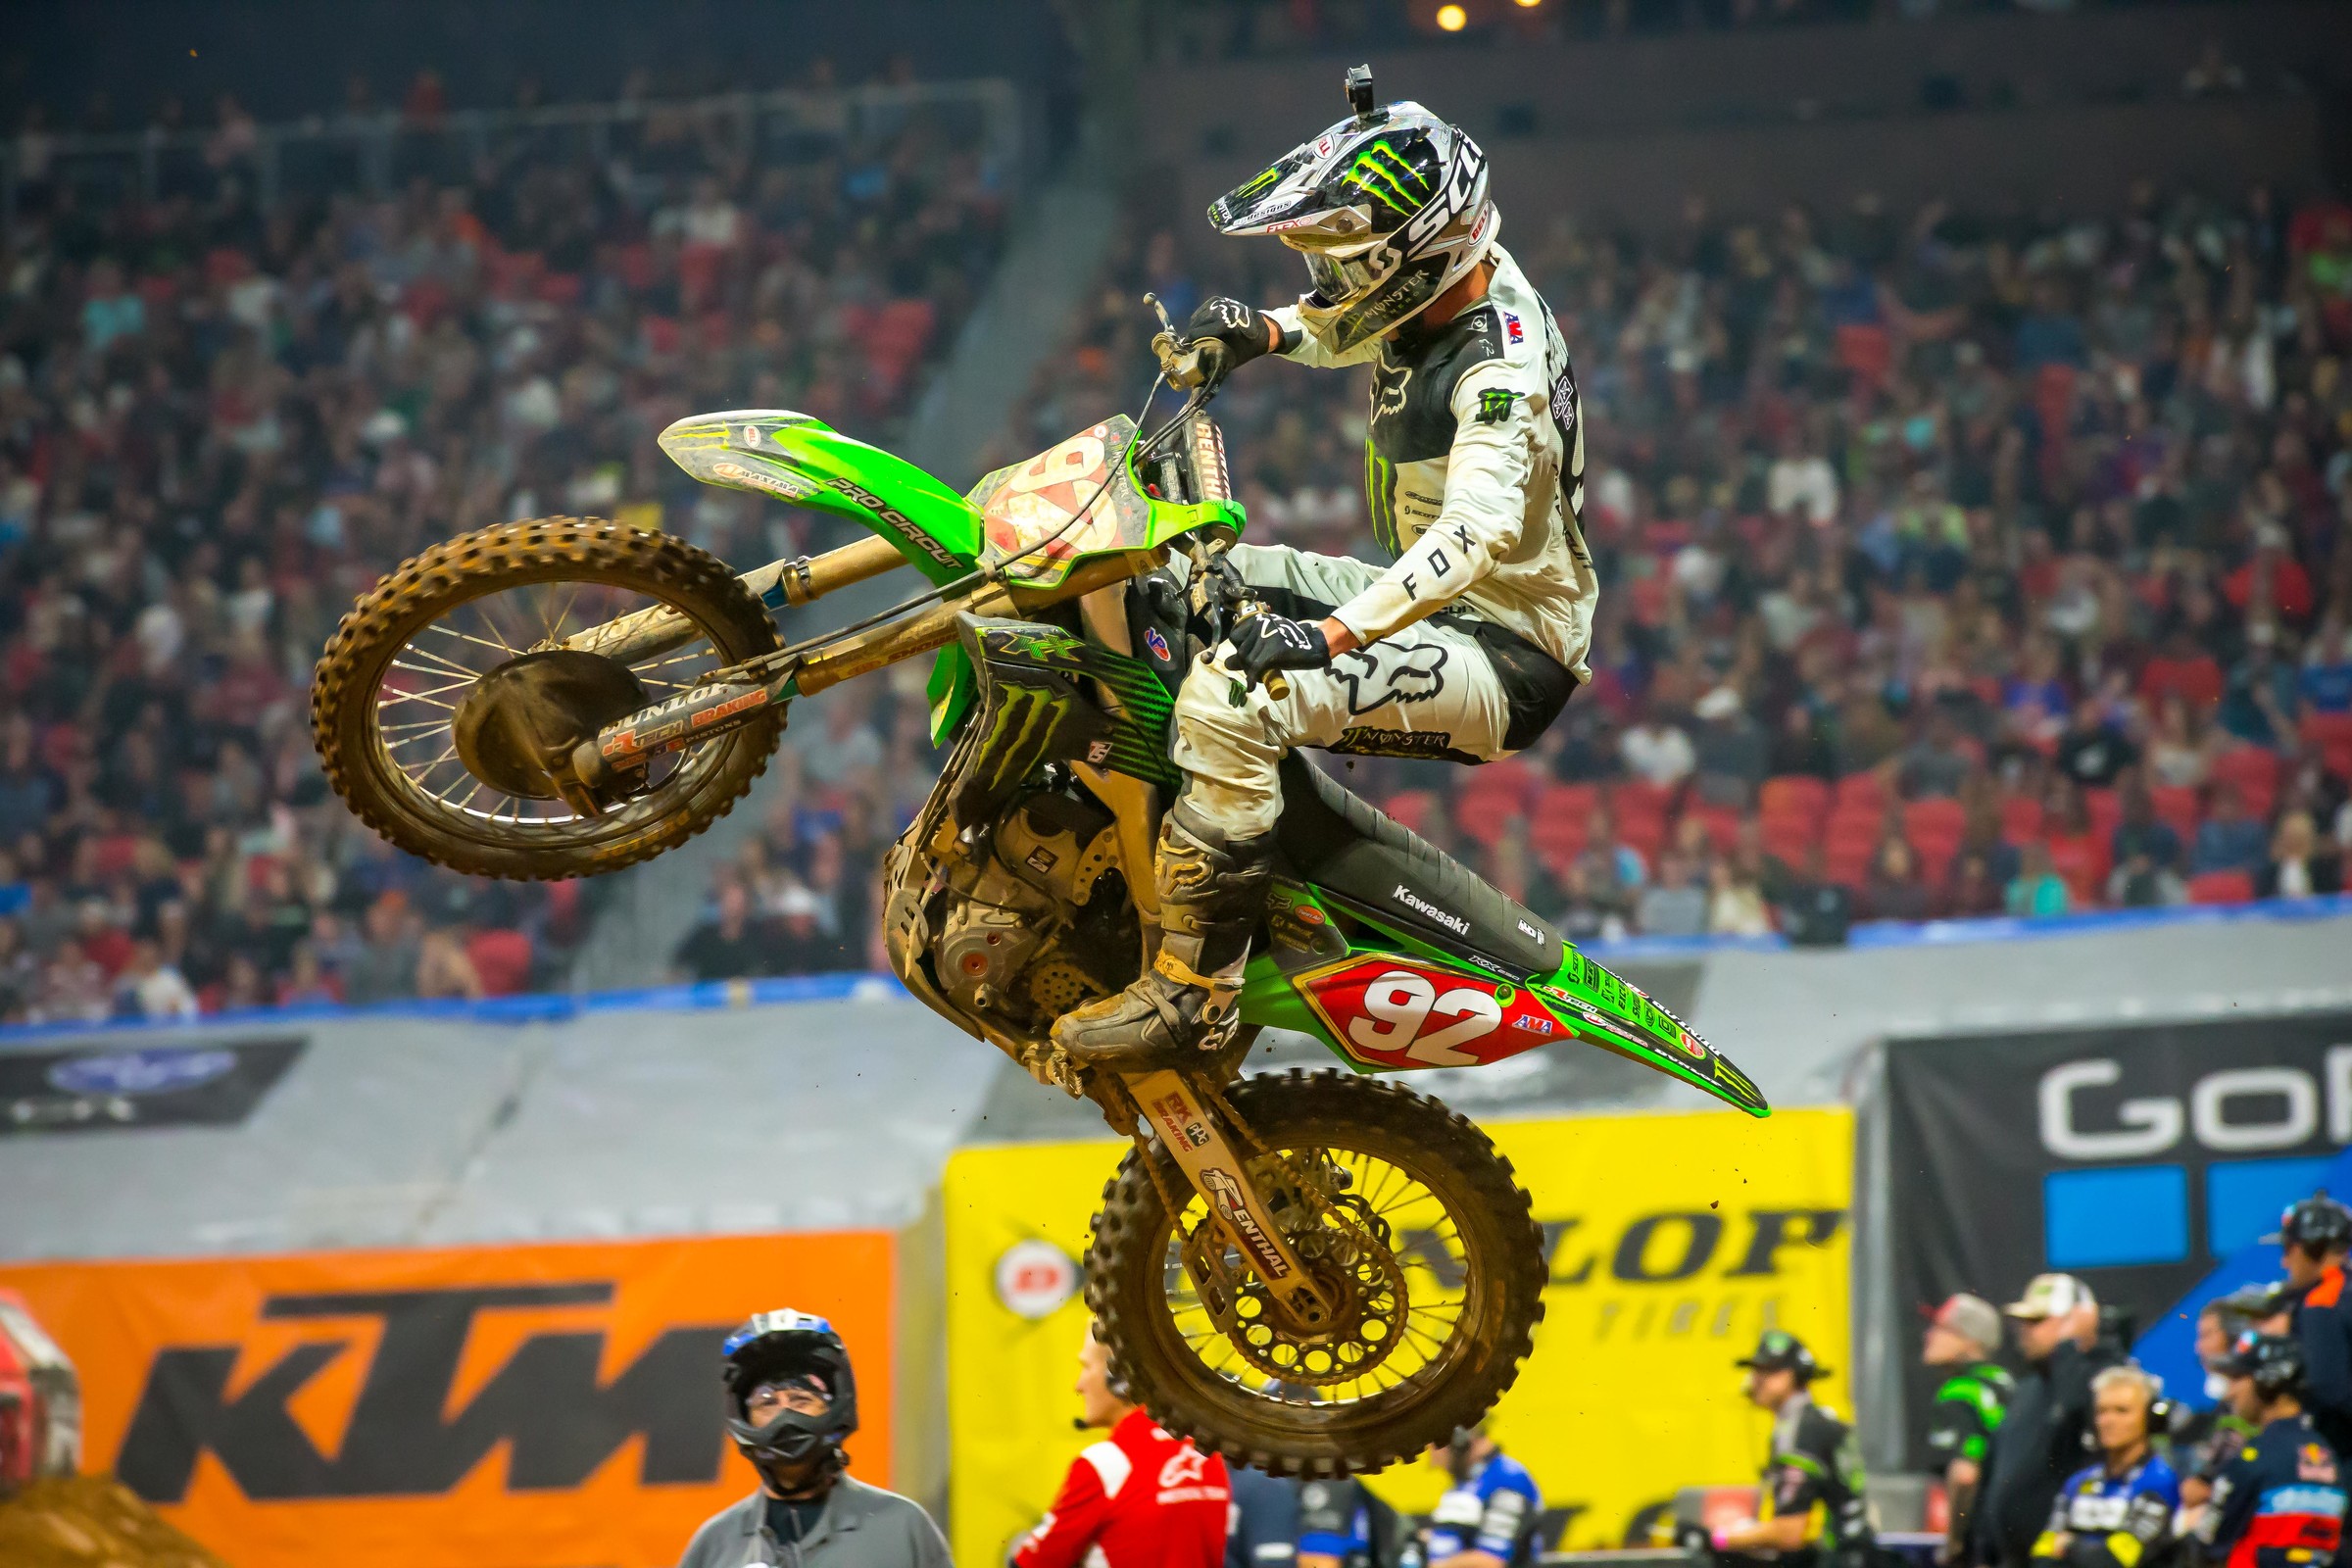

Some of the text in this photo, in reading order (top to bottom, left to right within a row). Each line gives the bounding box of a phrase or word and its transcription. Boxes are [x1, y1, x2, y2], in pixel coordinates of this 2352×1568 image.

[1266, 220, 1300, 234] FLEX
[1471, 210, 1489, 241] BELL
[1503, 311, 1524, 345] AMA
[825, 476, 964, 570] PRO CIRCUIT
[1401, 523, 1477, 602] FOX
[690, 688, 768, 728] BRAKING
[1393, 884, 1471, 936] Kawasaki
[1348, 969, 1503, 1066] 92
[1514, 1013, 1554, 1036] AMA
[1165, 1091, 1194, 1126] RK
[1188, 1124, 1209, 1147] PPG
[1200, 1167, 1290, 1279] RENTHAL
[115, 1283, 745, 1505] KTM
